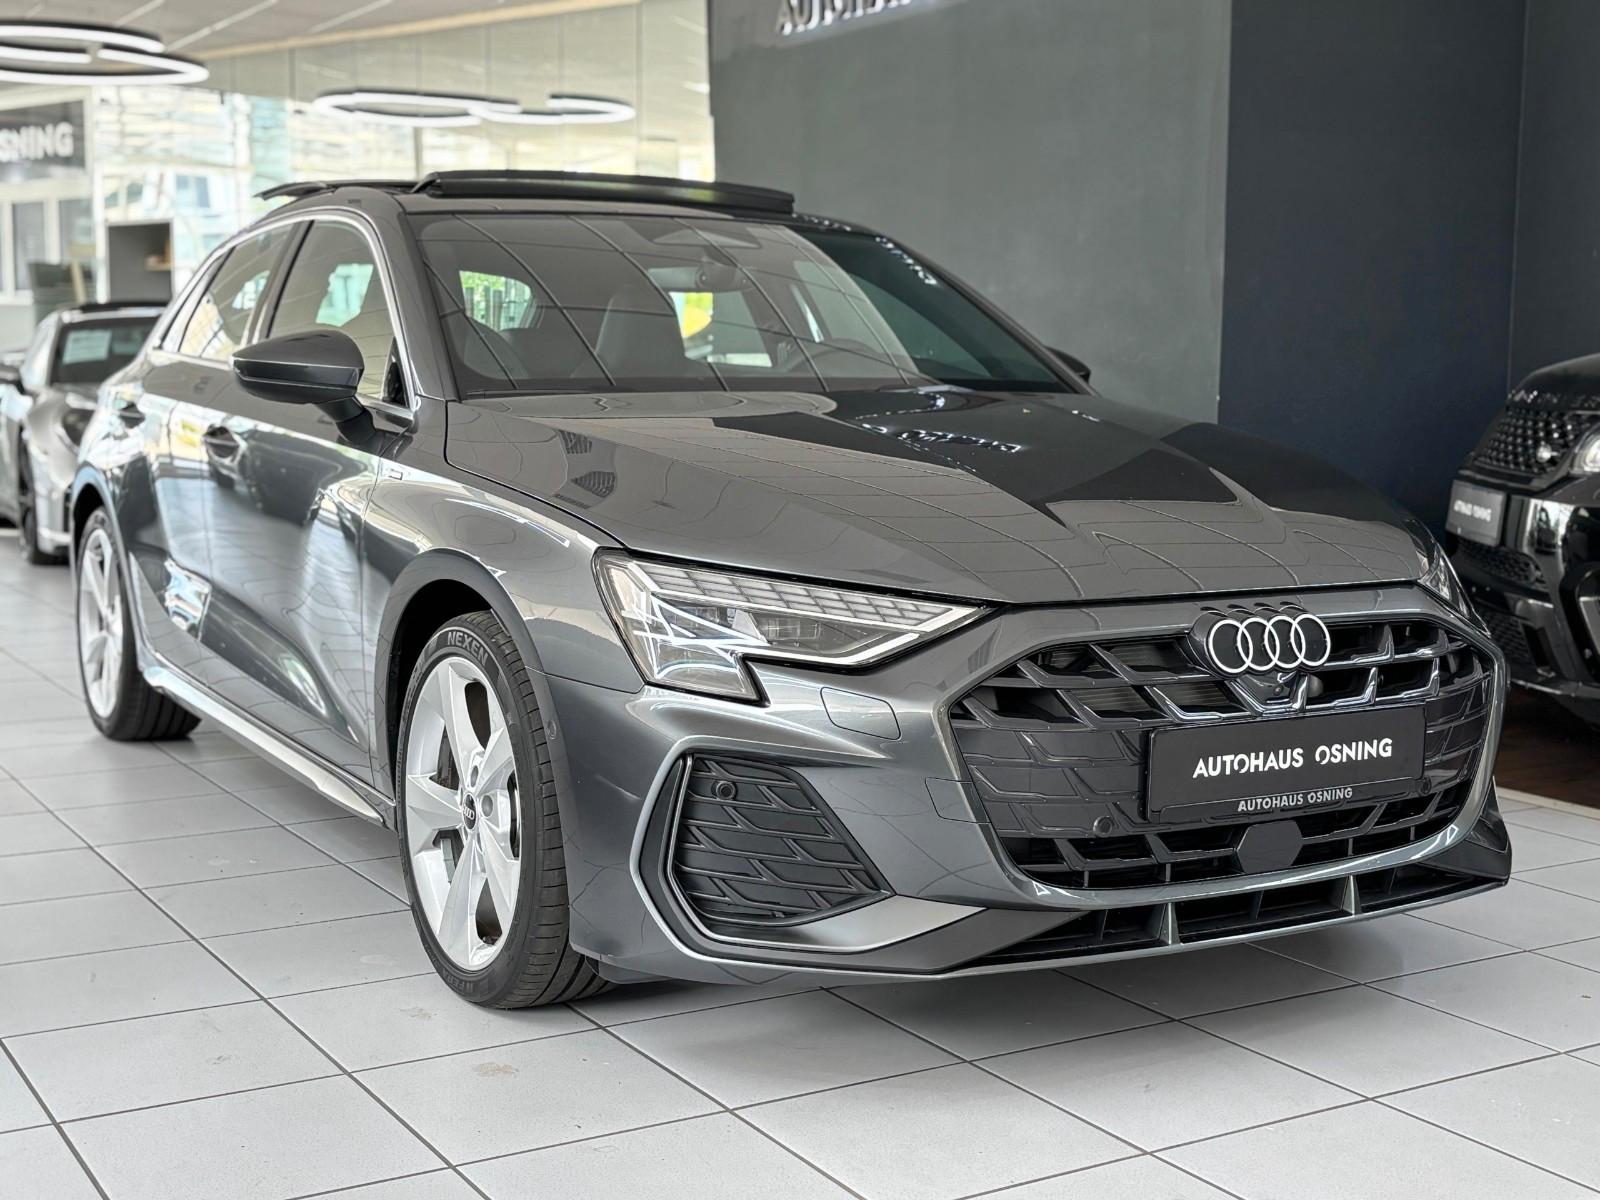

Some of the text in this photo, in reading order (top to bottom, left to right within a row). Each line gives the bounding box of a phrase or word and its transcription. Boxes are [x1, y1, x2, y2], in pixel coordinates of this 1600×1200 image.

[447, 631, 488, 665] NEXEN
[1192, 738, 1393, 779] AUTOHAUS OSNING
[1237, 787, 1353, 812] AUTOHAUS OSNING
